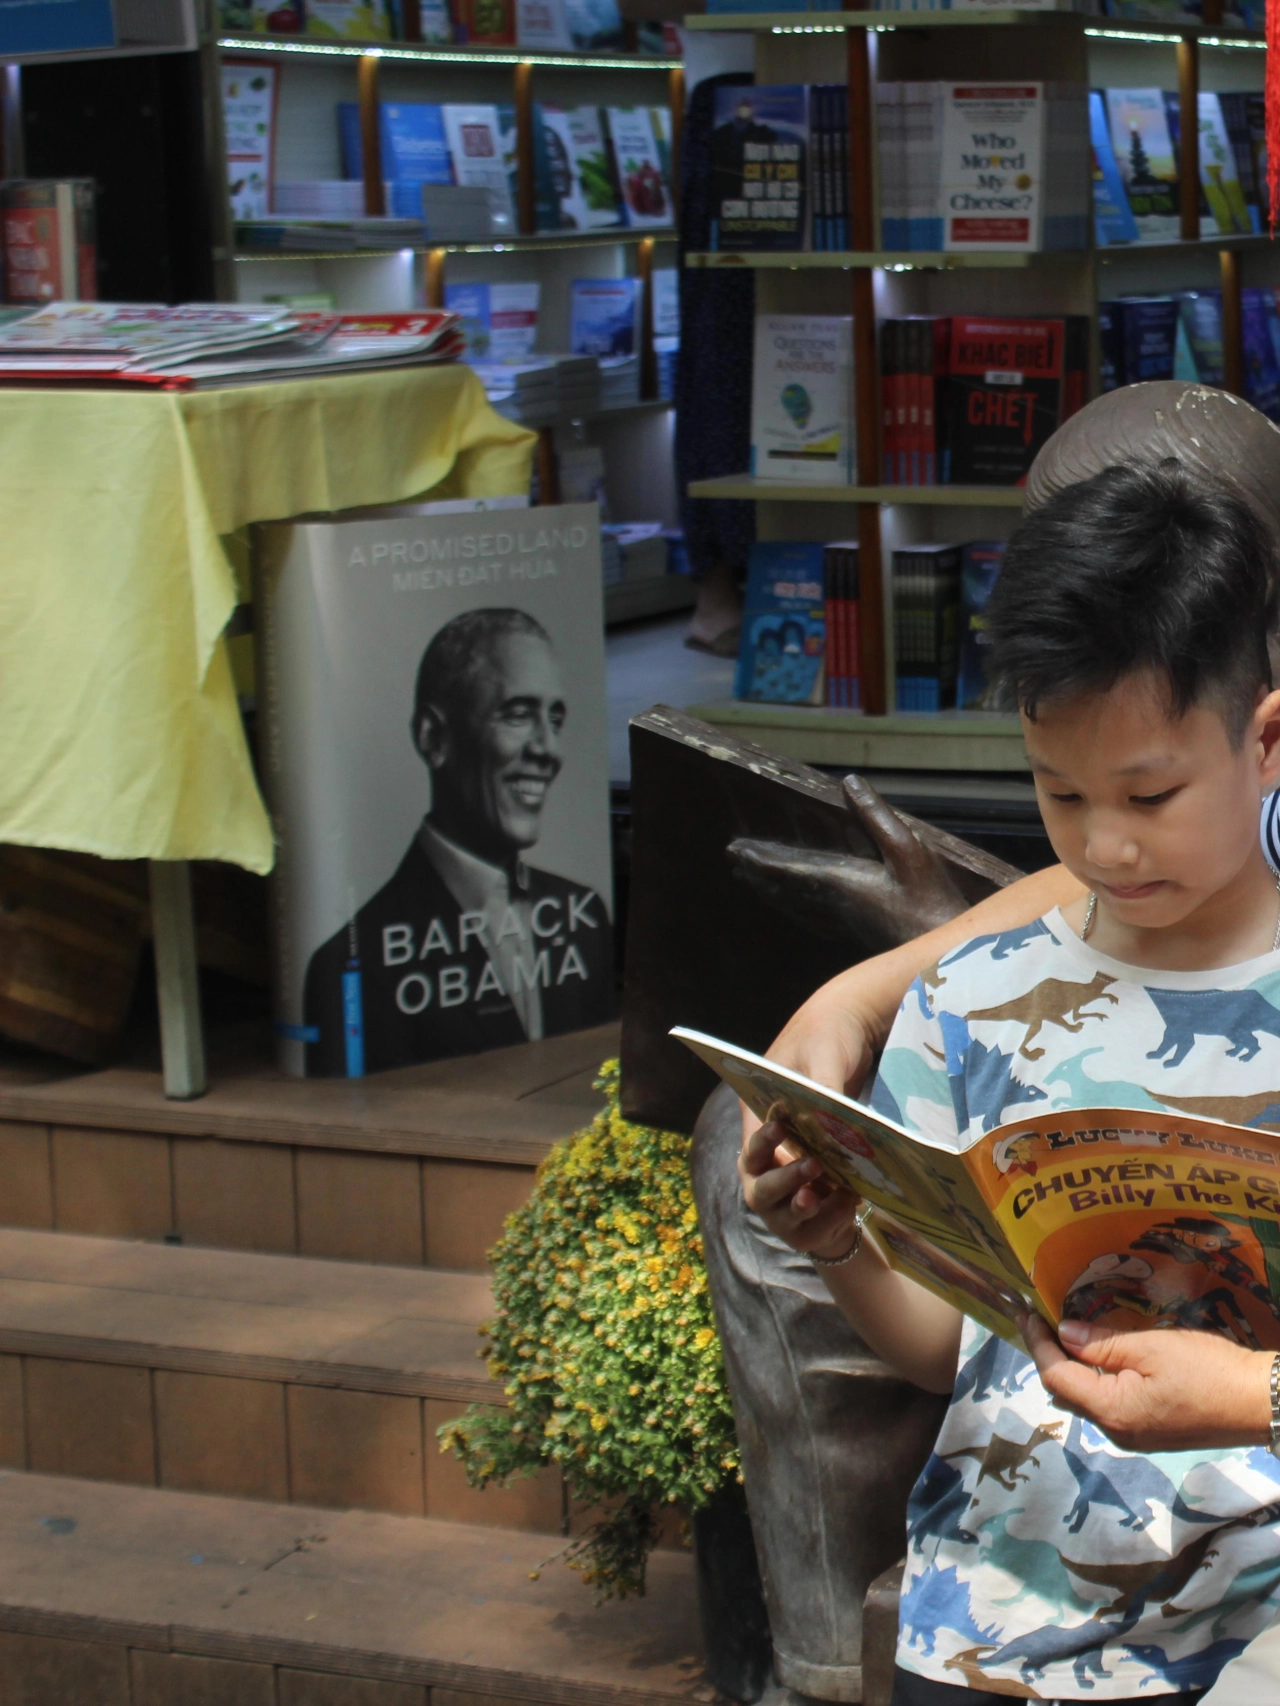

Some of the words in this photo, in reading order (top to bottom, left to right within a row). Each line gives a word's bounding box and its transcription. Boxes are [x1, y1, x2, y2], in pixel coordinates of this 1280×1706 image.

[972, 132, 1016, 149] Who
[977, 174, 1008, 193] My
[950, 194, 1032, 211] Cheese?
[347, 545, 368, 569] A
[371, 532, 516, 568] PROMISED
[517, 525, 589, 555] LAND
[381, 891, 599, 967] BARACK
[395, 944, 590, 1015] OBAMA
[1176, 1131, 1277, 1166] LUKE
[1012, 1158, 1176, 1220] CHUYẾN
[1186, 1160, 1241, 1189] ÁP
[1068, 1182, 1157, 1212] Billy
[1163, 1182, 1234, 1206] The
